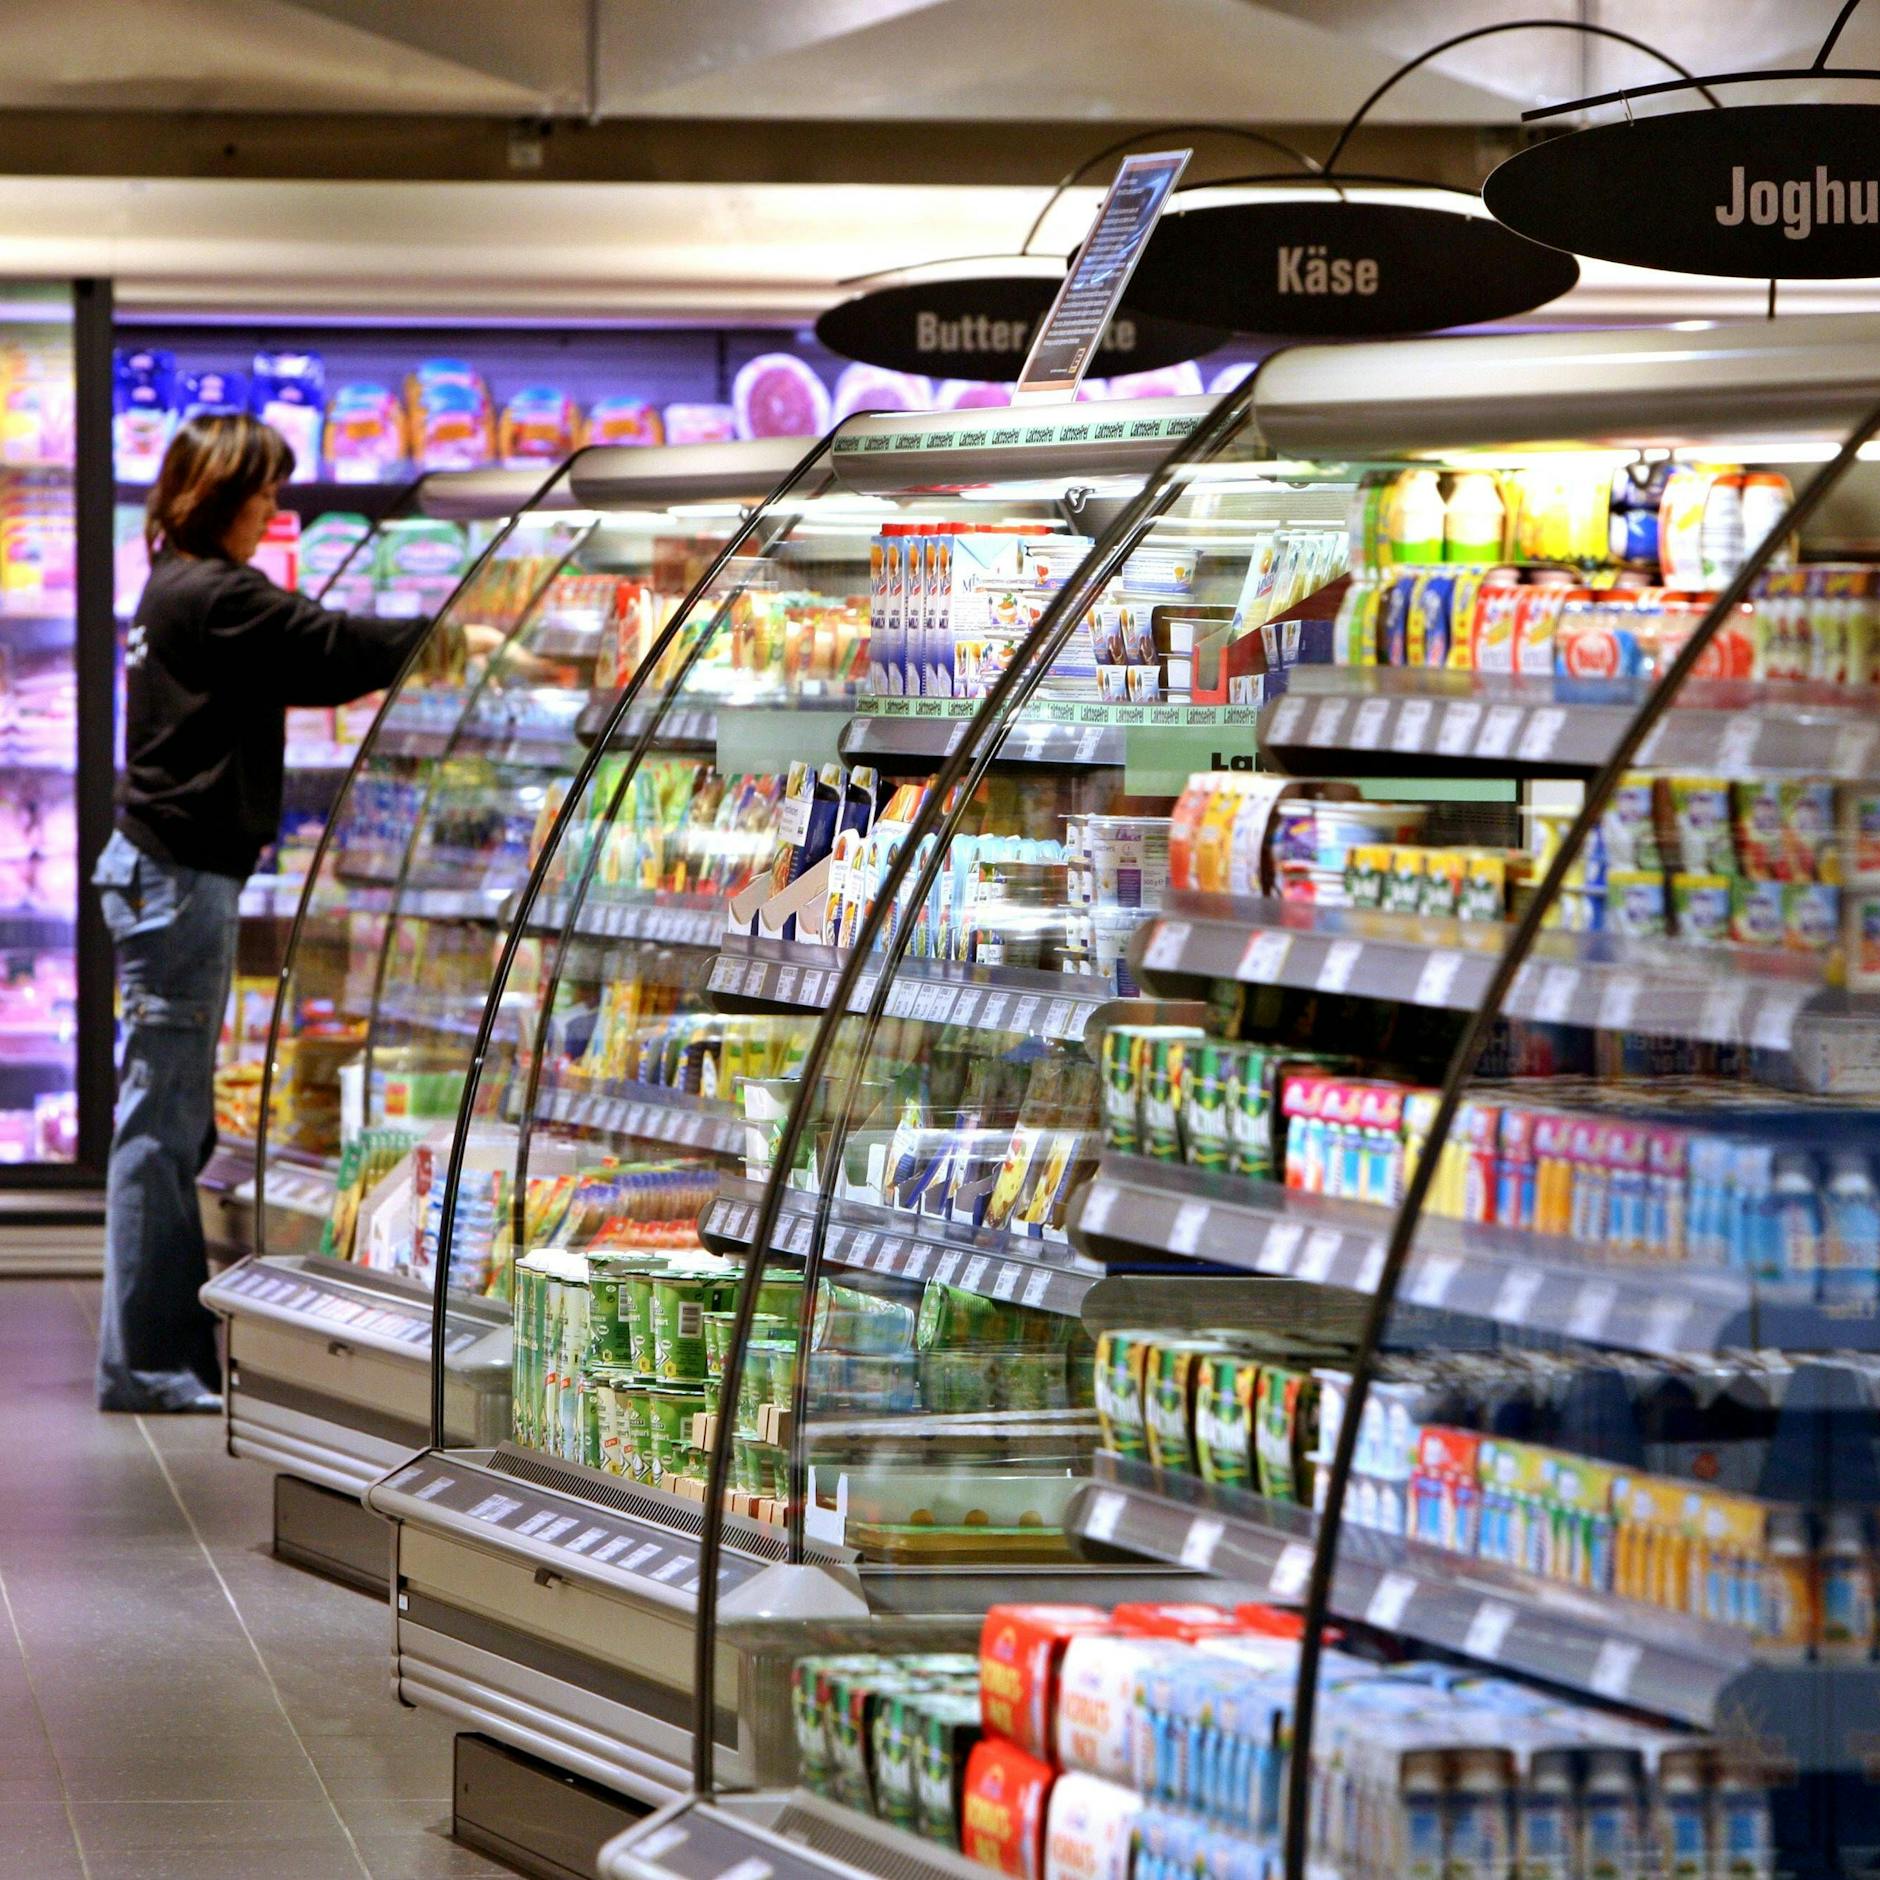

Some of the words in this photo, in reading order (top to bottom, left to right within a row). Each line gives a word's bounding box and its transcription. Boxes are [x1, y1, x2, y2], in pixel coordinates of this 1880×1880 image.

[1715, 165, 1879, 240] Joghu
[1278, 246, 1379, 295] Käse
[917, 311, 1028, 351] Butter
